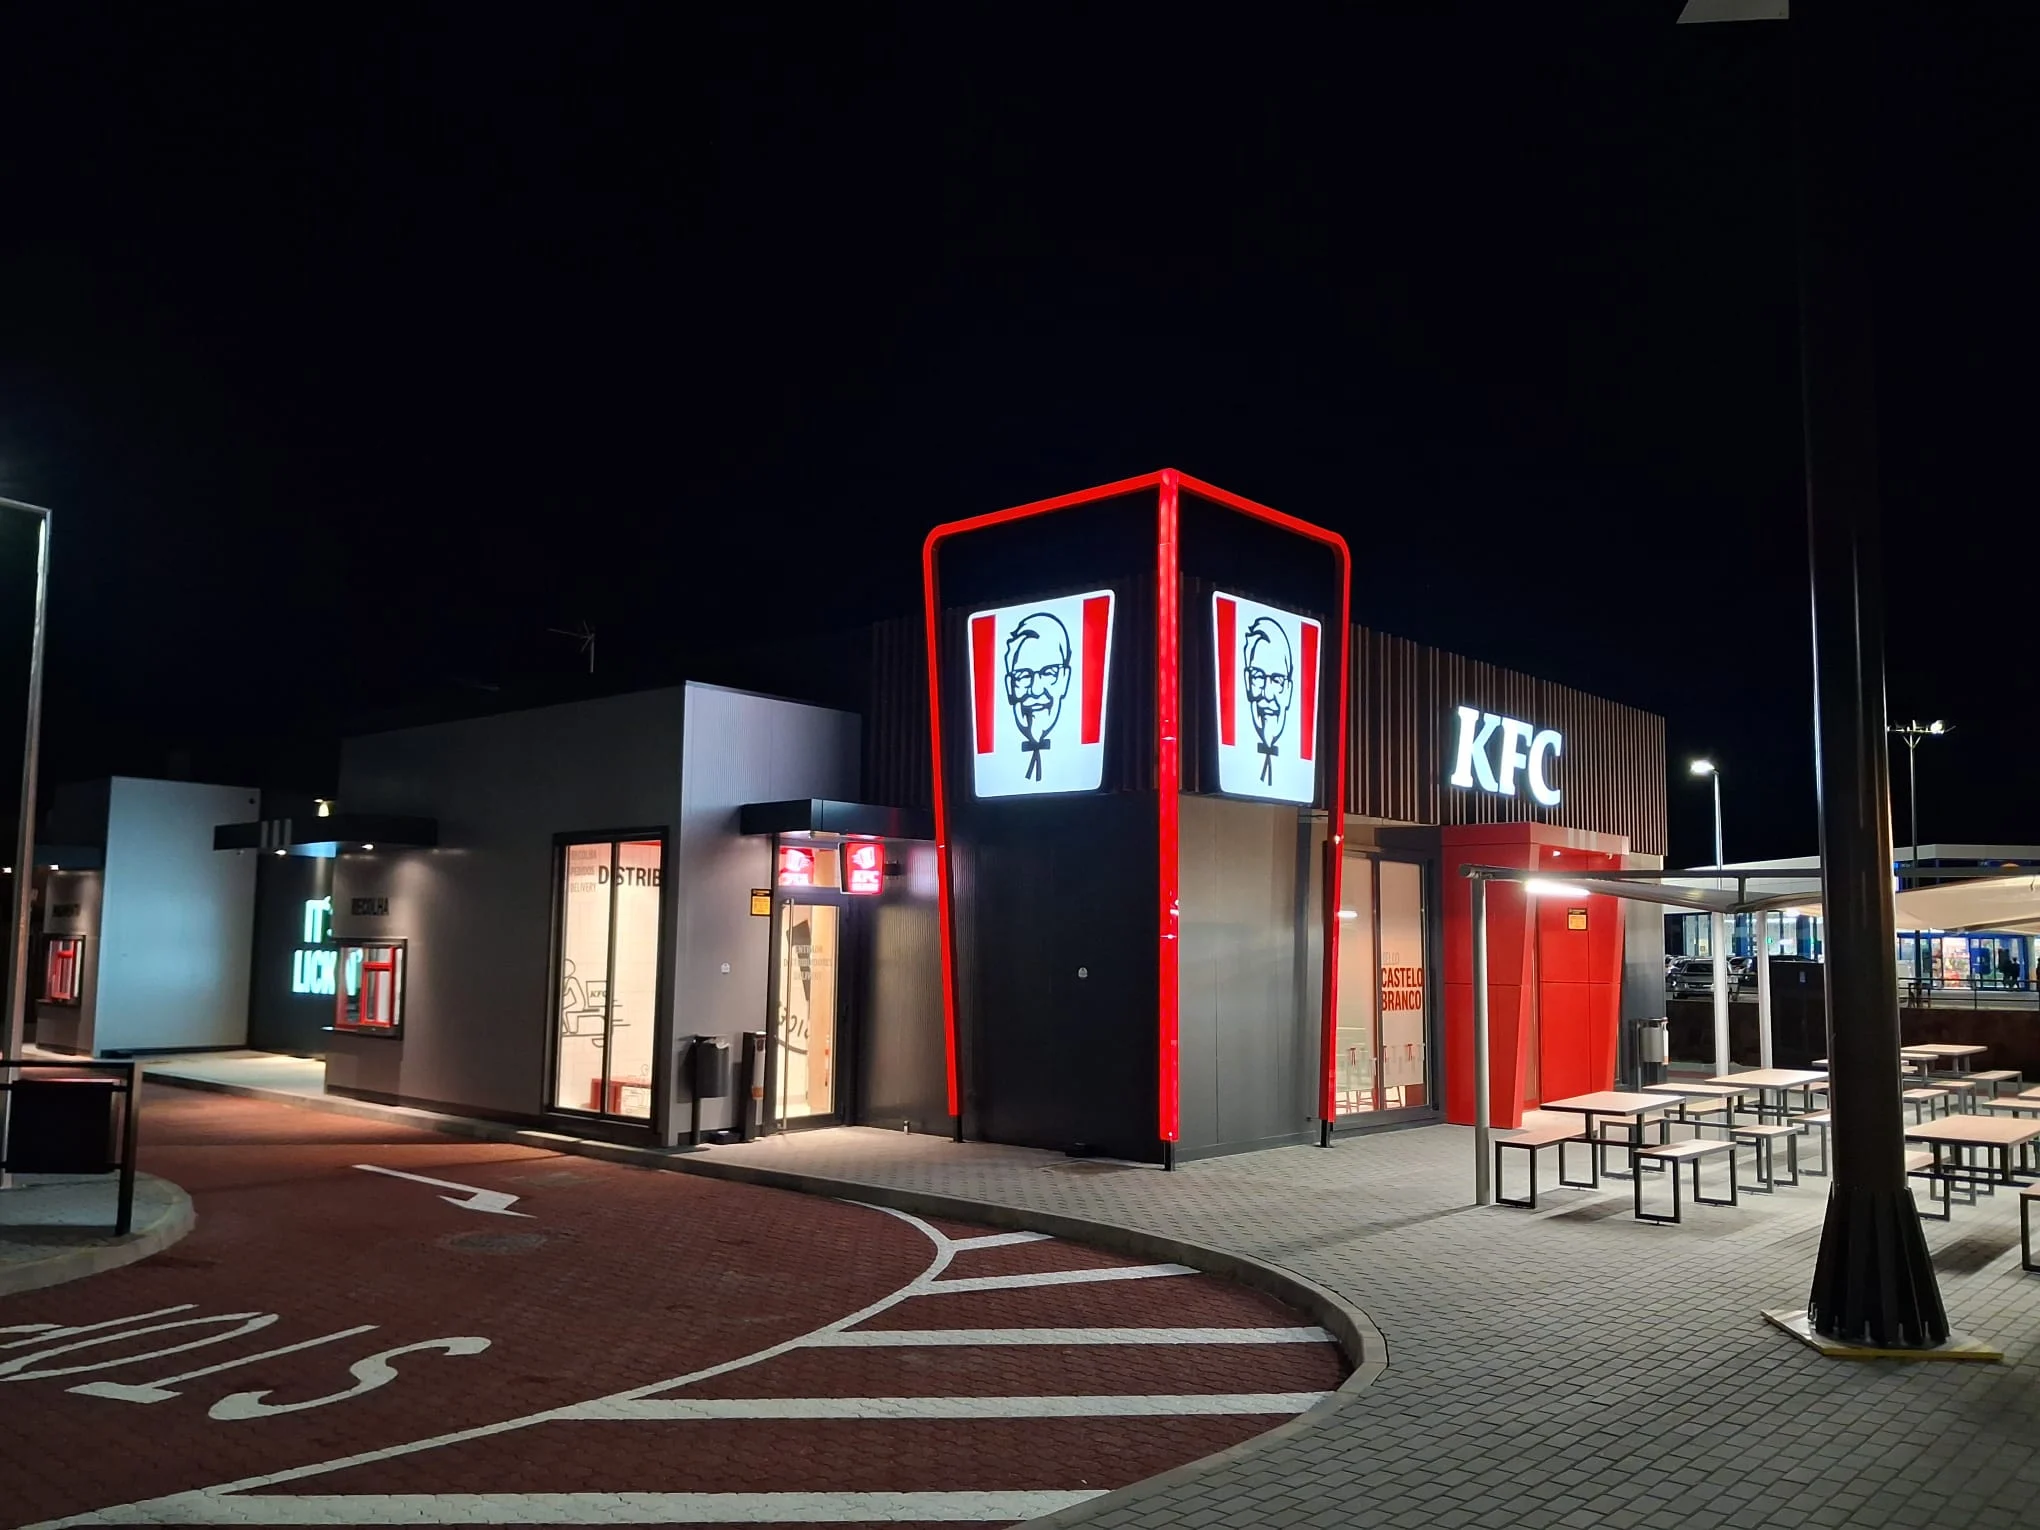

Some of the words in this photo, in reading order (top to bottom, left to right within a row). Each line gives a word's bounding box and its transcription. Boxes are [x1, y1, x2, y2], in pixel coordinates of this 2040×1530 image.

[1451, 706, 1562, 807] KFC
[598, 865, 661, 888] DSTRIB
[1381, 967, 1424, 988] CASTELO
[1381, 990, 1422, 1011] BRANCO
